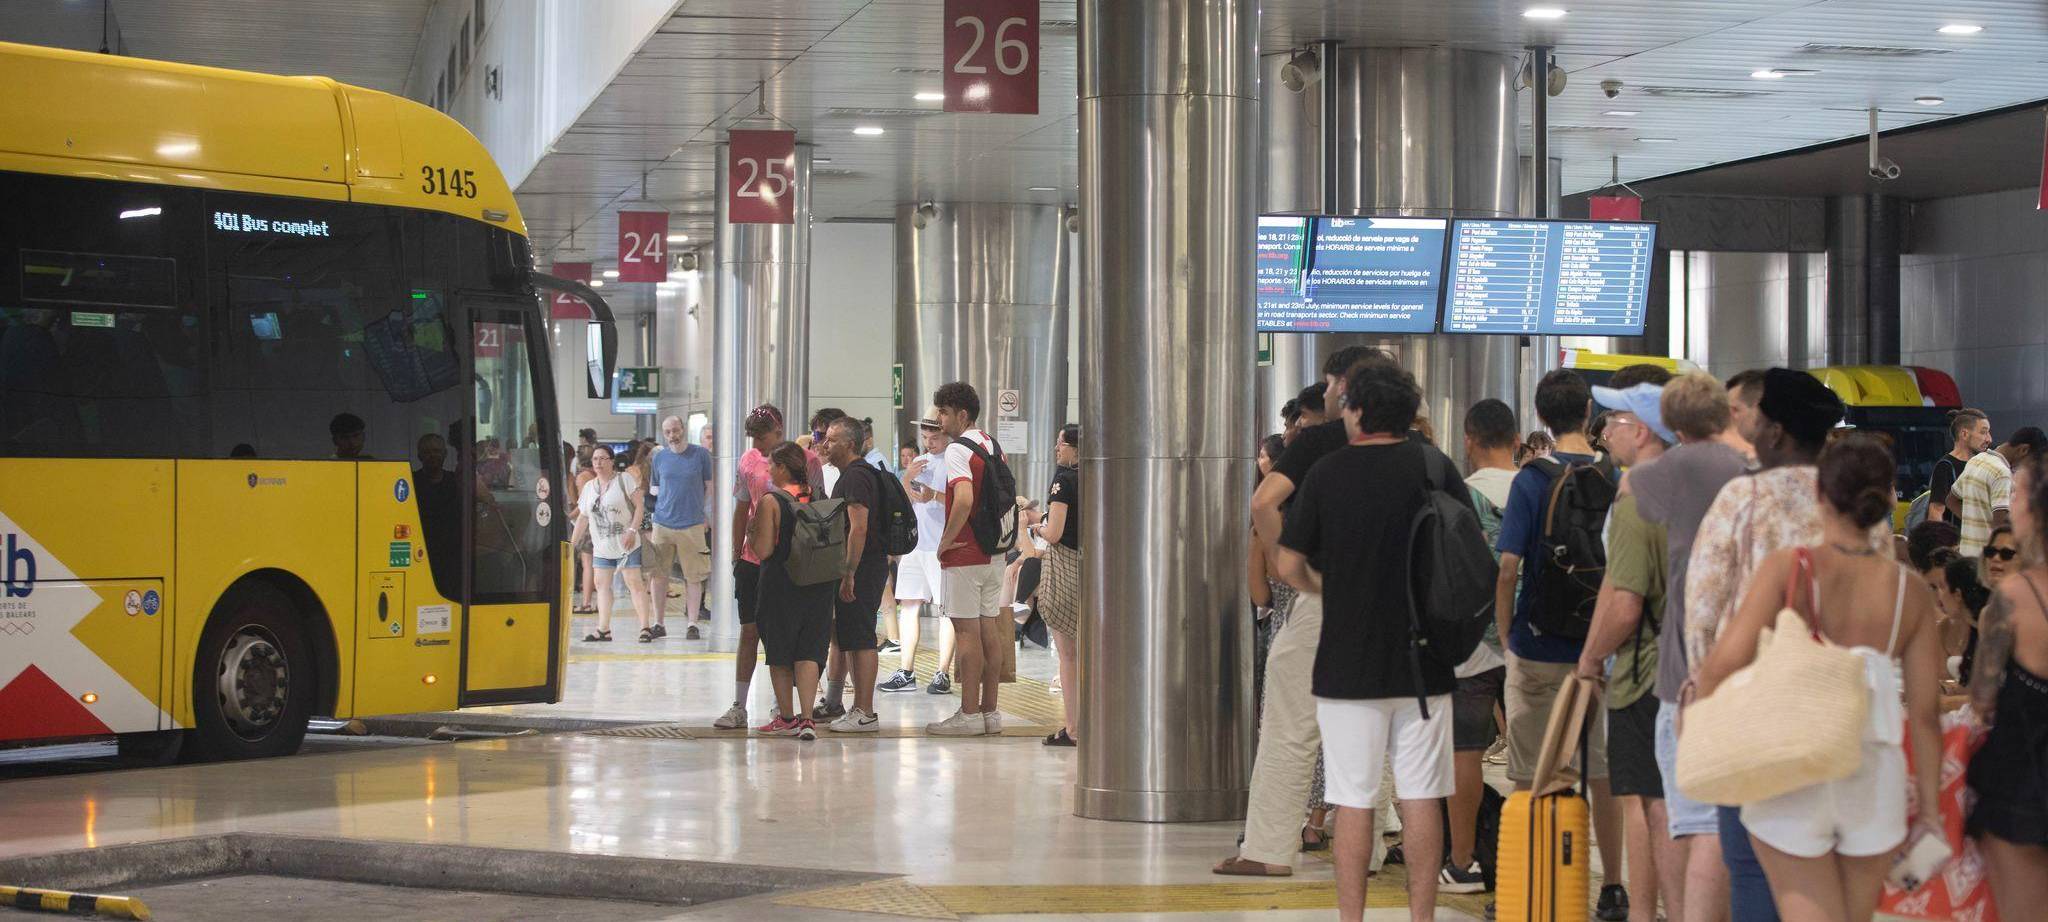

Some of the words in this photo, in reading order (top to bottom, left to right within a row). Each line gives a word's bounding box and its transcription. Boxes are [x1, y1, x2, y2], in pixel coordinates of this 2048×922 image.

[953, 16, 1029, 76] 26
[421, 166, 477, 199] 3145
[737, 158, 787, 198] 25
[214, 211, 239, 231] 401
[242, 213, 268, 233] Bus
[272, 219, 330, 237] complet
[623, 232, 663, 263] 24
[1401, 270, 1421, 278] huelga
[1401, 303, 1424, 311] general
[478, 329, 499, 347] 21
